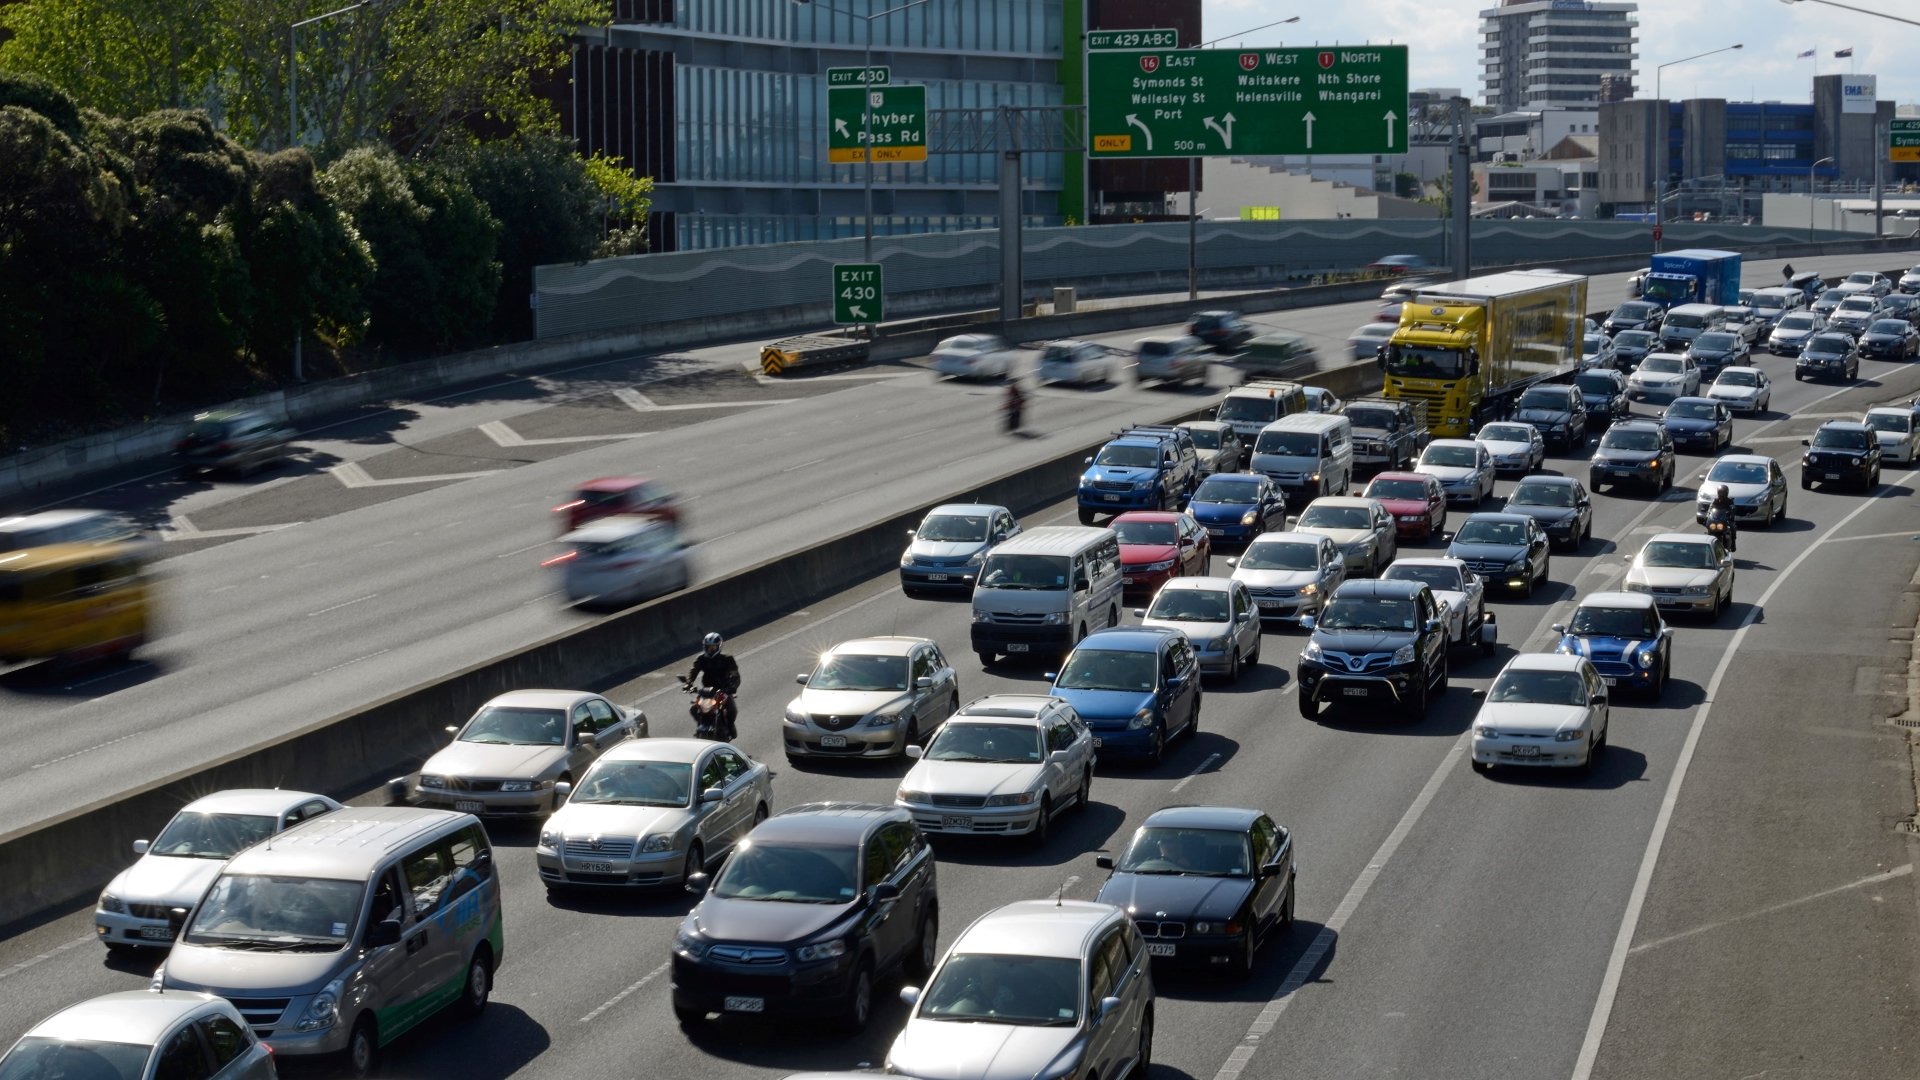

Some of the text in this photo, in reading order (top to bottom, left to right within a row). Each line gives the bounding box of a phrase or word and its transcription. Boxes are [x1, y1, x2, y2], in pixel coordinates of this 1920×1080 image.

[1091, 36, 1110, 45] EXIT
[1114, 34, 1139, 46] 429
[1144, 55, 1196, 68] 16 EAST
[1243, 53, 1299, 66] 16 WEST
[1341, 51, 1381, 63] NORTH
[832, 70, 885, 82] EXIT 430
[1238, 75, 1300, 86] Waitakere
[1318, 73, 1381, 84] Nth Shore
[1132, 76, 1204, 90] Symonds St
[872, 95, 881, 104] 12
[1131, 92, 1206, 106] Wellesley St
[1236, 91, 1302, 102] Helensville
[1319, 89, 1381, 104] Whangarei
[1154, 109, 1182, 119] Port
[857, 130, 919, 144] Pass Rd
[1100, 139, 1126, 147] ONLY
[1174, 140, 1194, 150] 500
[877, 150, 901, 159] ONLY
[841, 271, 874, 282] EXIT
[841, 286, 876, 300] 430
